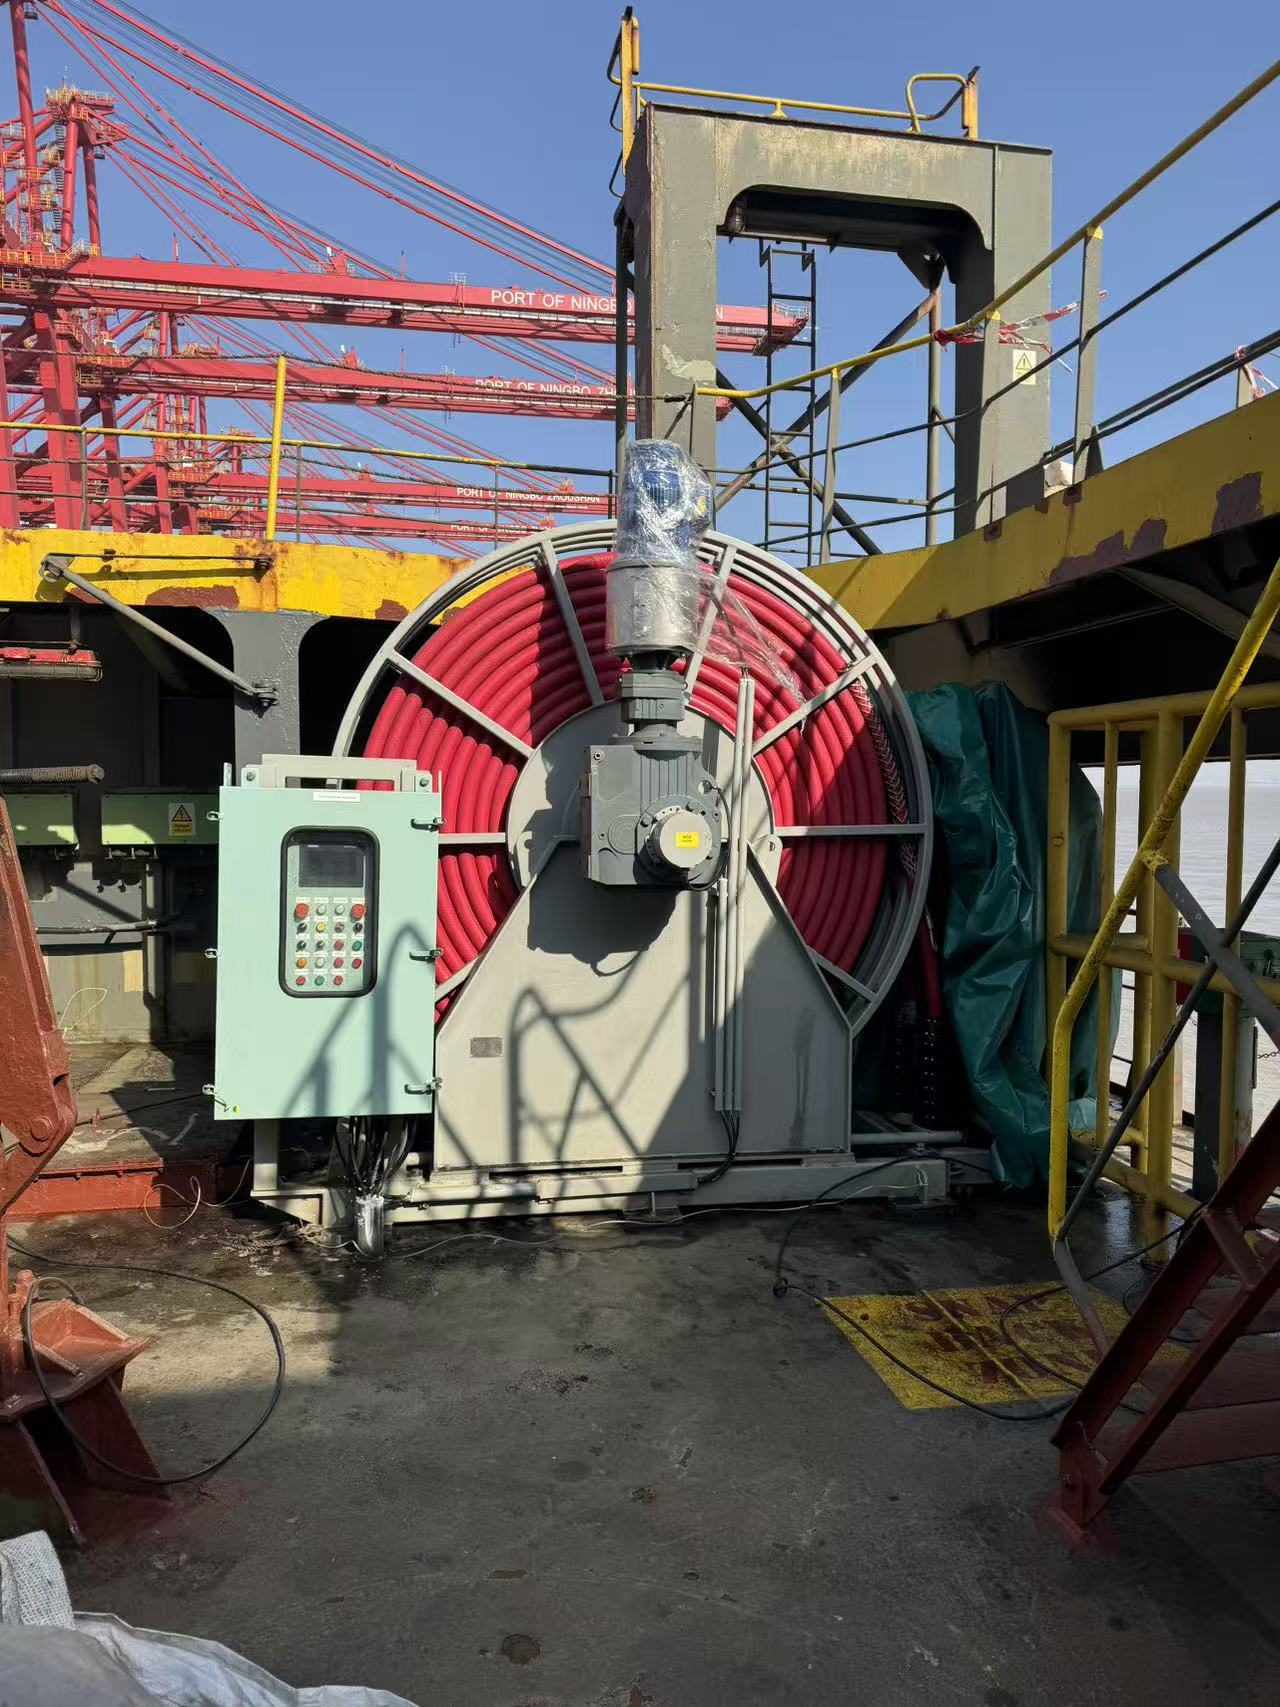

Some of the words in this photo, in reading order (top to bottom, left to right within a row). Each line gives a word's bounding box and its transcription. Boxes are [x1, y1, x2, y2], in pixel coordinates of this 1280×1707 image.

[491, 290, 536, 305] PORT
[542, 294, 565, 308] OF
[475, 378, 511, 392] PORT
[517, 382, 536, 392] OF
[540, 384, 591, 395] NINGBO
[457, 487, 483, 497] PORT
